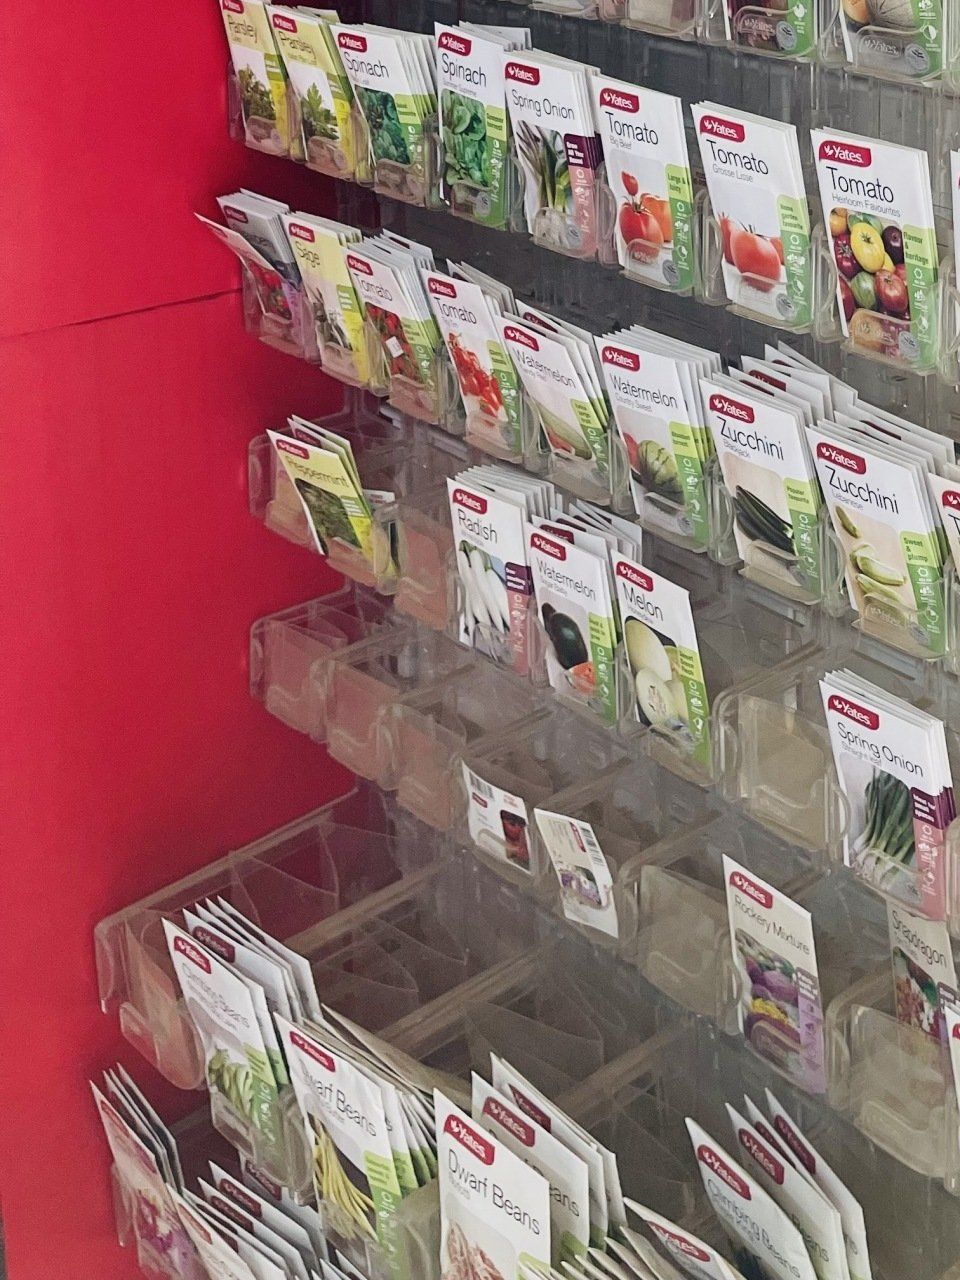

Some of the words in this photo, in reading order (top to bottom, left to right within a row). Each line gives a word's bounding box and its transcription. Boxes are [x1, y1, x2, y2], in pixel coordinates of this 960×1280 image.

[344, 53, 389, 79] Spinach
[442, 54, 487, 87] Spinach
[512, 88, 542, 116] Spring
[543, 98, 575, 120] Onion
[605, 111, 659, 146] Tomato
[707, 139, 769, 175] Tomato
[826, 166, 895, 204] Tomato
[296, 241, 320, 268] Sage
[352, 273, 393, 303] Tomato
[434, 297, 478, 326] Tomato
[516, 349, 577, 389] Watermelon
[609, 376, 678, 410] Watermelon
[719, 417, 785, 462] Zucchini
[286, 456, 348, 488] Peppermint
[825, 465, 900, 515] Zucchini
[457, 508, 498, 544] Radish
[537, 555, 596, 601] Watermelon
[622, 583, 664, 621] Melon
[838, 722, 881, 759] Spring
[882, 745, 923, 777] Onion
[735, 894, 770, 937] Rockery
[771, 918, 810, 956] Mixture
[892, 913, 947, 968] Snapdragon
[336, 1089, 378, 1138] Beans
[448, 1149, 489, 1197] Dwarf
[493, 1181, 540, 1236] Beans
[761, 1227, 801, 1278] Beans
